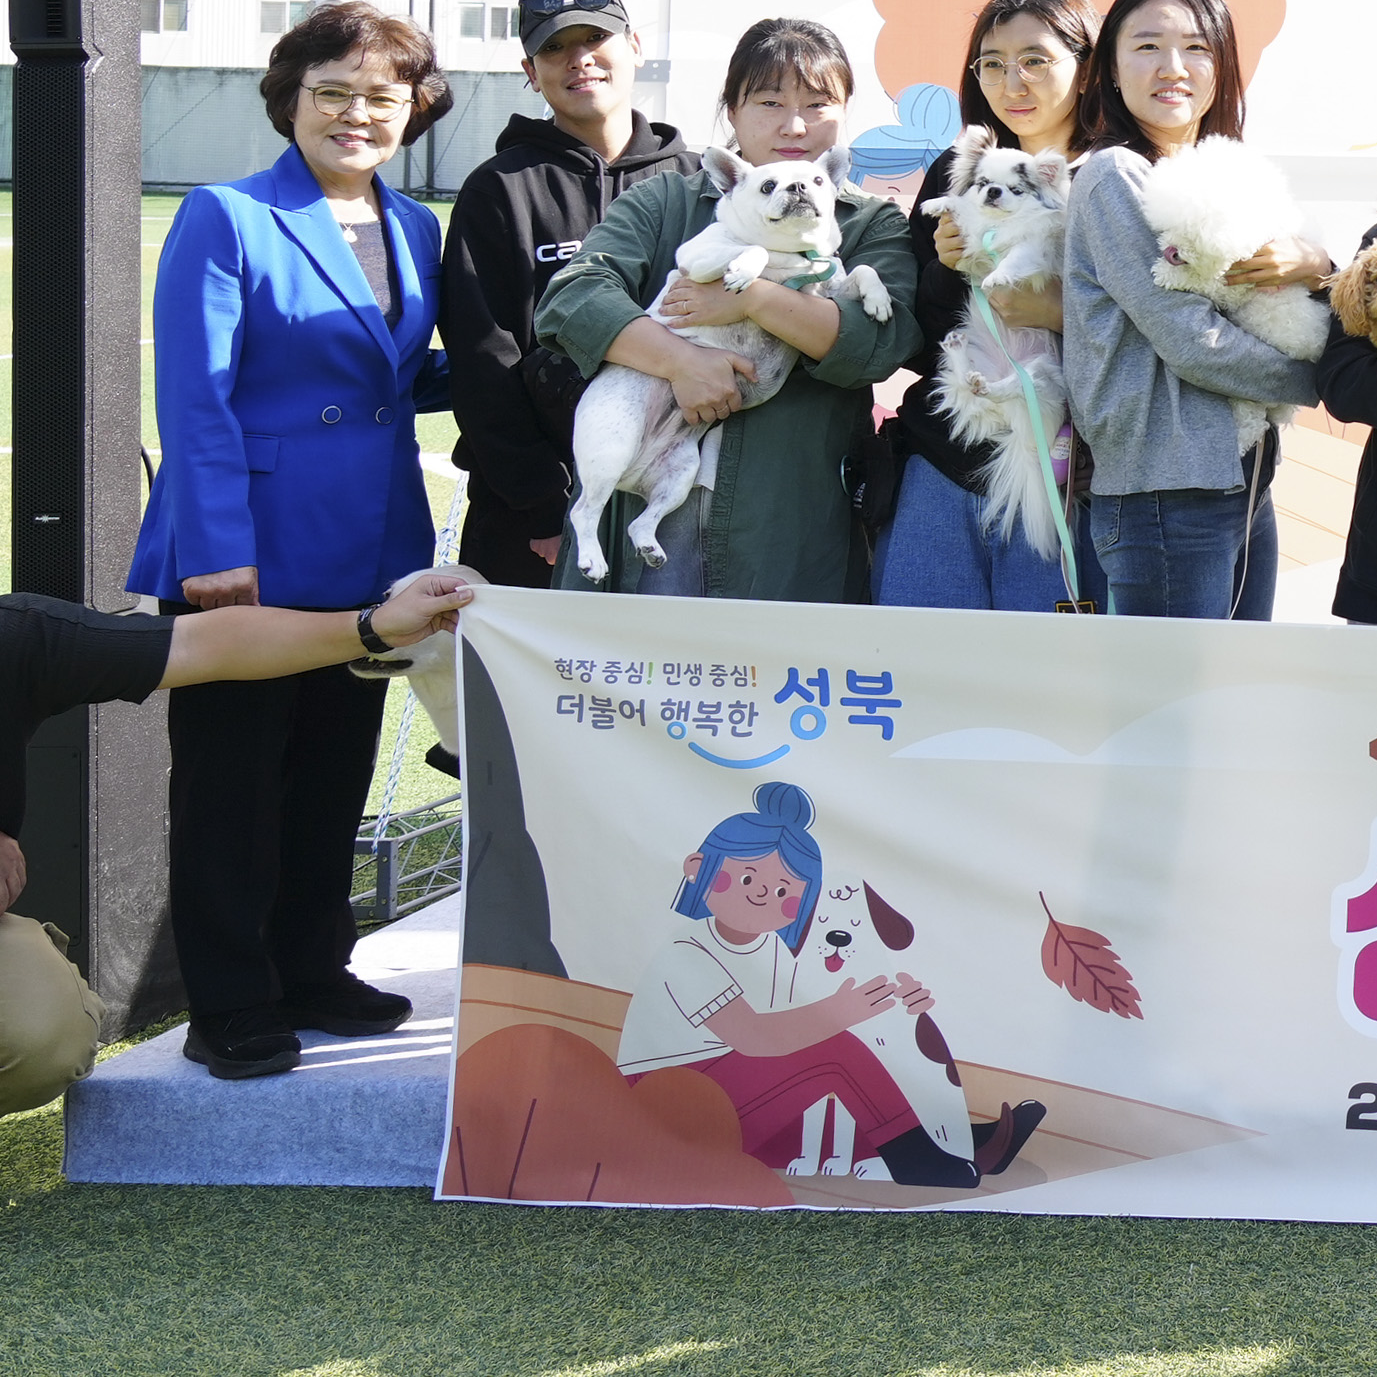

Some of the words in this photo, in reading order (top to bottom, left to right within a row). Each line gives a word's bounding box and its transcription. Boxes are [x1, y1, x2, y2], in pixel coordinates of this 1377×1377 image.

[554, 657, 597, 686] 현장
[601, 659, 654, 687] 중심!
[662, 660, 703, 688] 민생
[708, 663, 757, 689] 중심!
[556, 692, 647, 731] 더불어
[660, 698, 759, 740] 행복한
[773, 666, 903, 742] 성북
